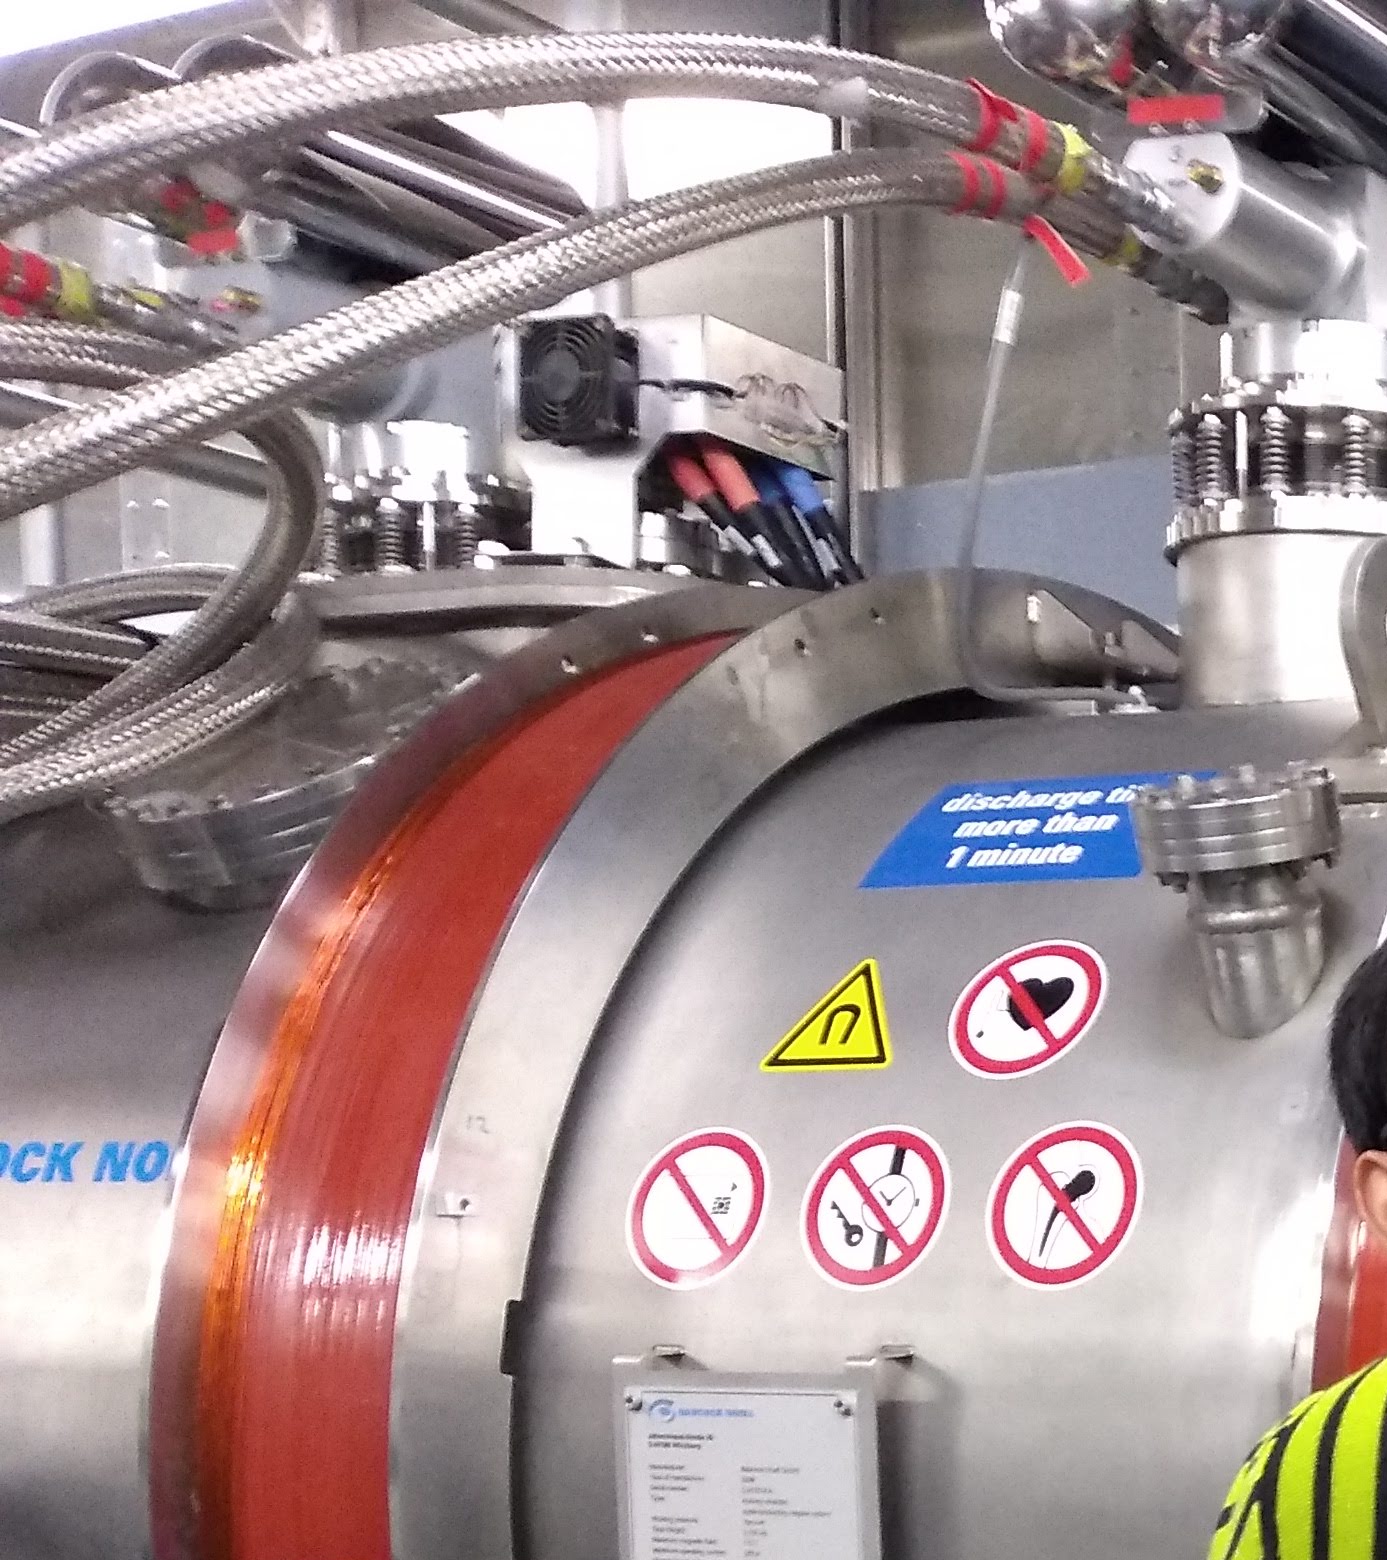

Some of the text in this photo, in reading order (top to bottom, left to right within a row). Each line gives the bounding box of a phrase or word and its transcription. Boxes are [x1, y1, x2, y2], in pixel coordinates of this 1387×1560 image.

[941, 784, 1144, 812] discharge ti
[953, 812, 1120, 838] more than
[945, 842, 1085, 868] 1 minute
[92, 1141, 169, 1183] NO
